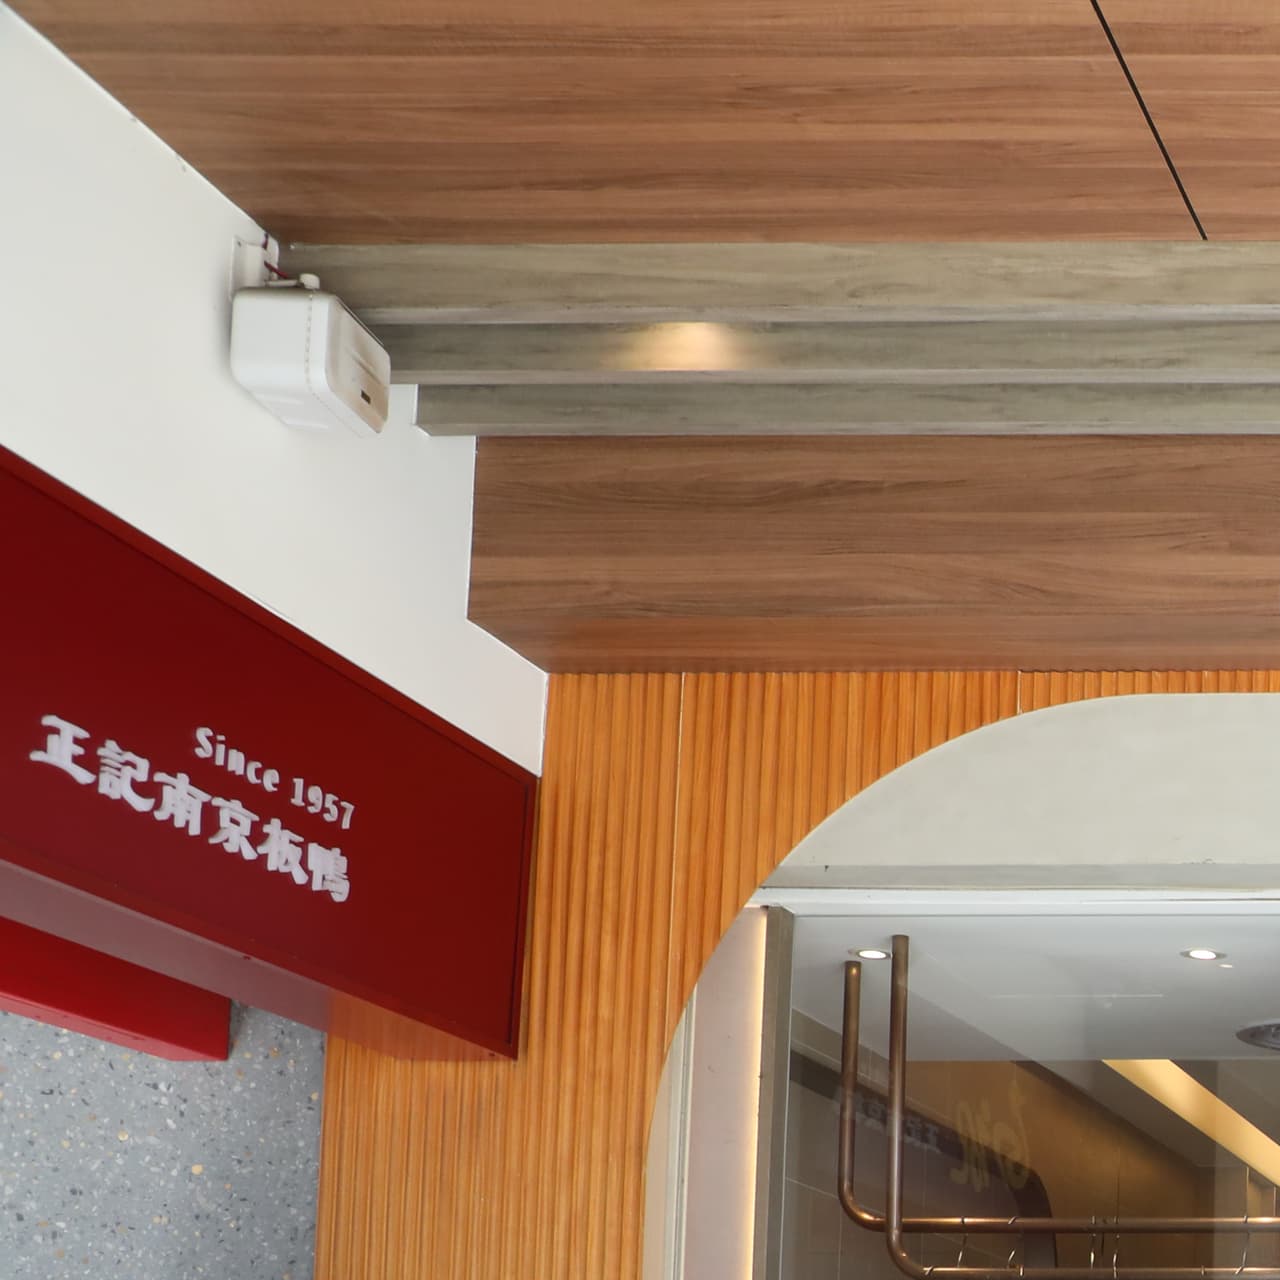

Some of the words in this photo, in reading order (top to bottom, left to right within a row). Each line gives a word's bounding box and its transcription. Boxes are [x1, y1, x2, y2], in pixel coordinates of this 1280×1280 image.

[29, 714, 351, 902] 正記南京板鴨
[195, 727, 280, 792] Since
[290, 777, 356, 829] 1957
